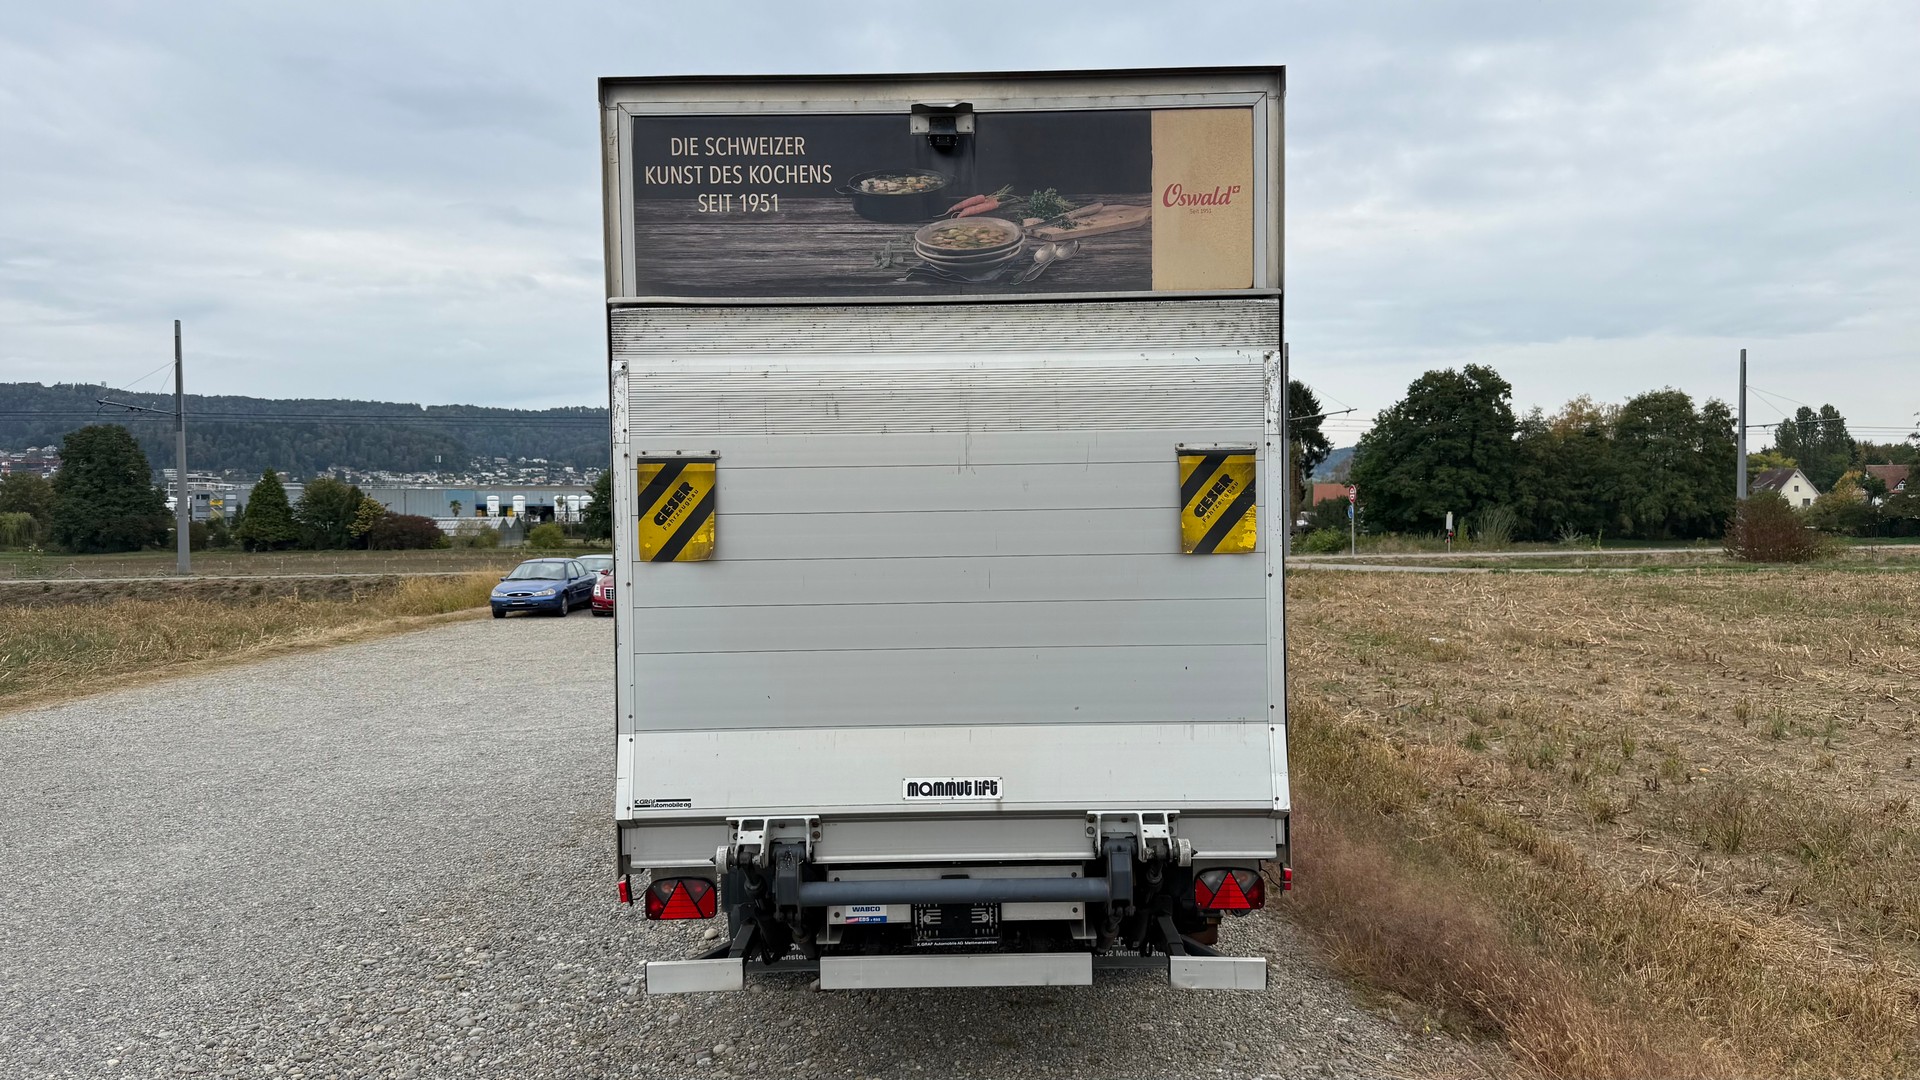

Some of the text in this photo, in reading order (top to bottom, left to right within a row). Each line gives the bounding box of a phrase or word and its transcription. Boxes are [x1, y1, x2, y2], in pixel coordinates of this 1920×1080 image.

[670, 136, 806, 156] DIE SCHWEIZER
[645, 164, 833, 185] KUNST DES KOCHENS
[697, 193, 779, 213] SEIT 1951
[1162, 183, 1232, 208] Oswald
[653, 481, 694, 526] GESER
[1193, 473, 1234, 518] GESER
[1201, 481, 1239, 523] Fahrzeugbau
[662, 489, 699, 531] Fahrzeugbau
[907, 779, 998, 797] mammut lift
